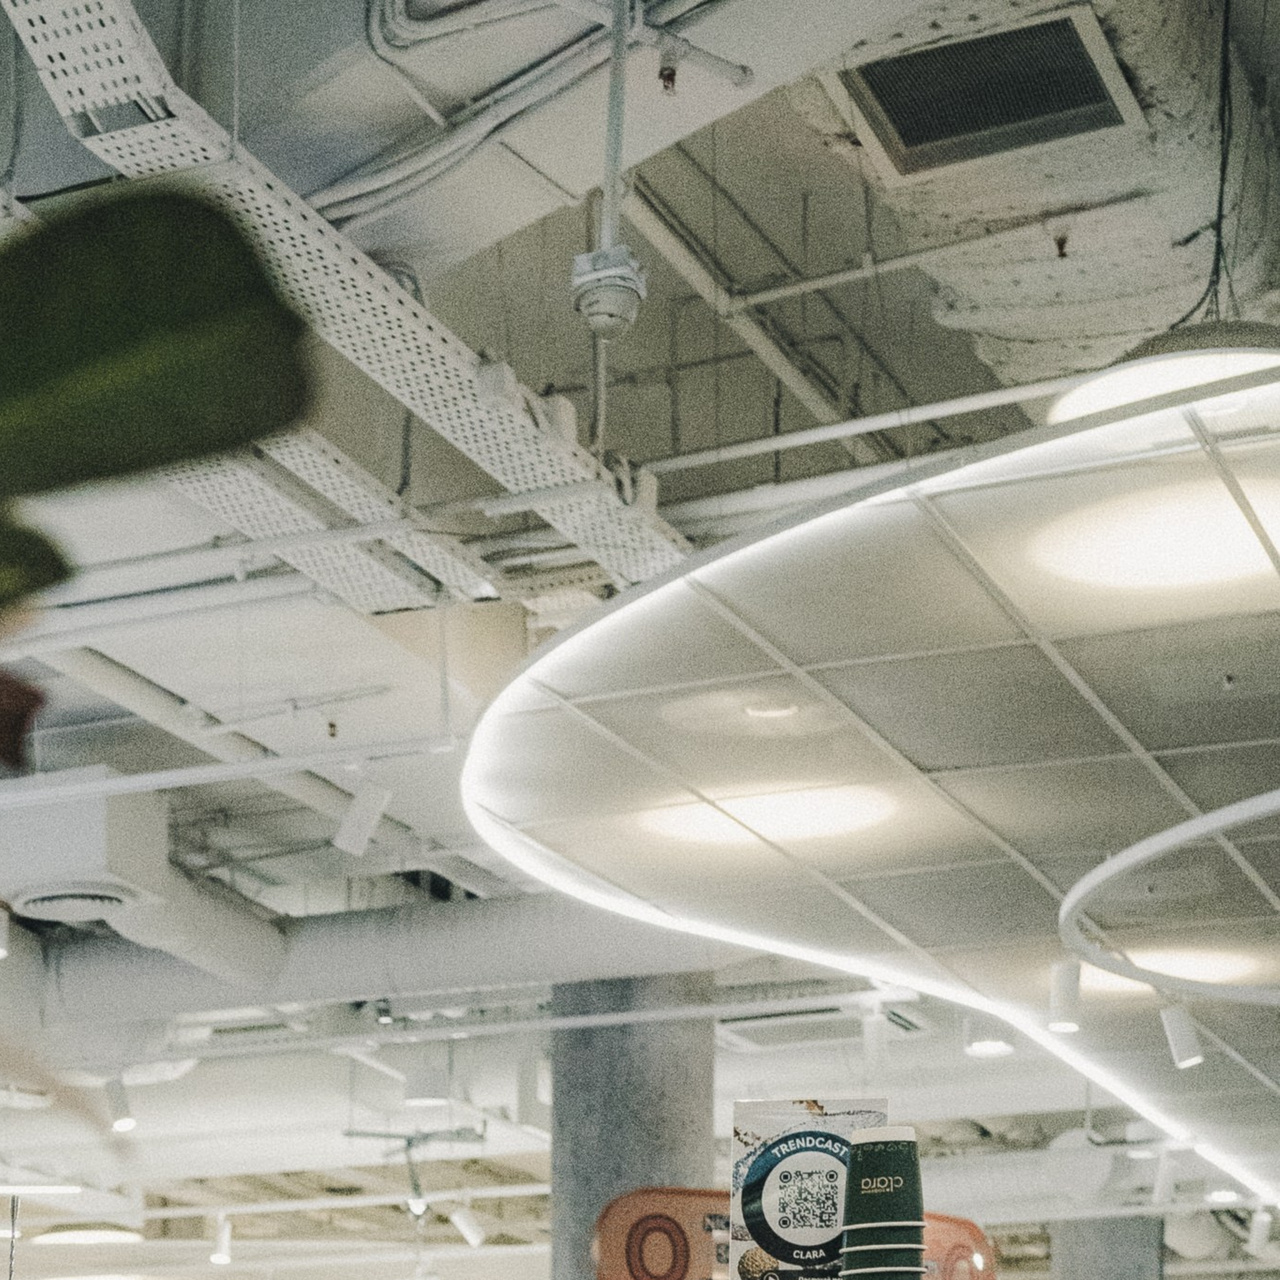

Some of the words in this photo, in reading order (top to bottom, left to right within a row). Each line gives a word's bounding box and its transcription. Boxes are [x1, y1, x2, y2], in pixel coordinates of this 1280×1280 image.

[771, 1136, 849, 1158] TRENDCAST
[861, 1176, 904, 1193] clara
[792, 1249, 826, 1260] CLARA
